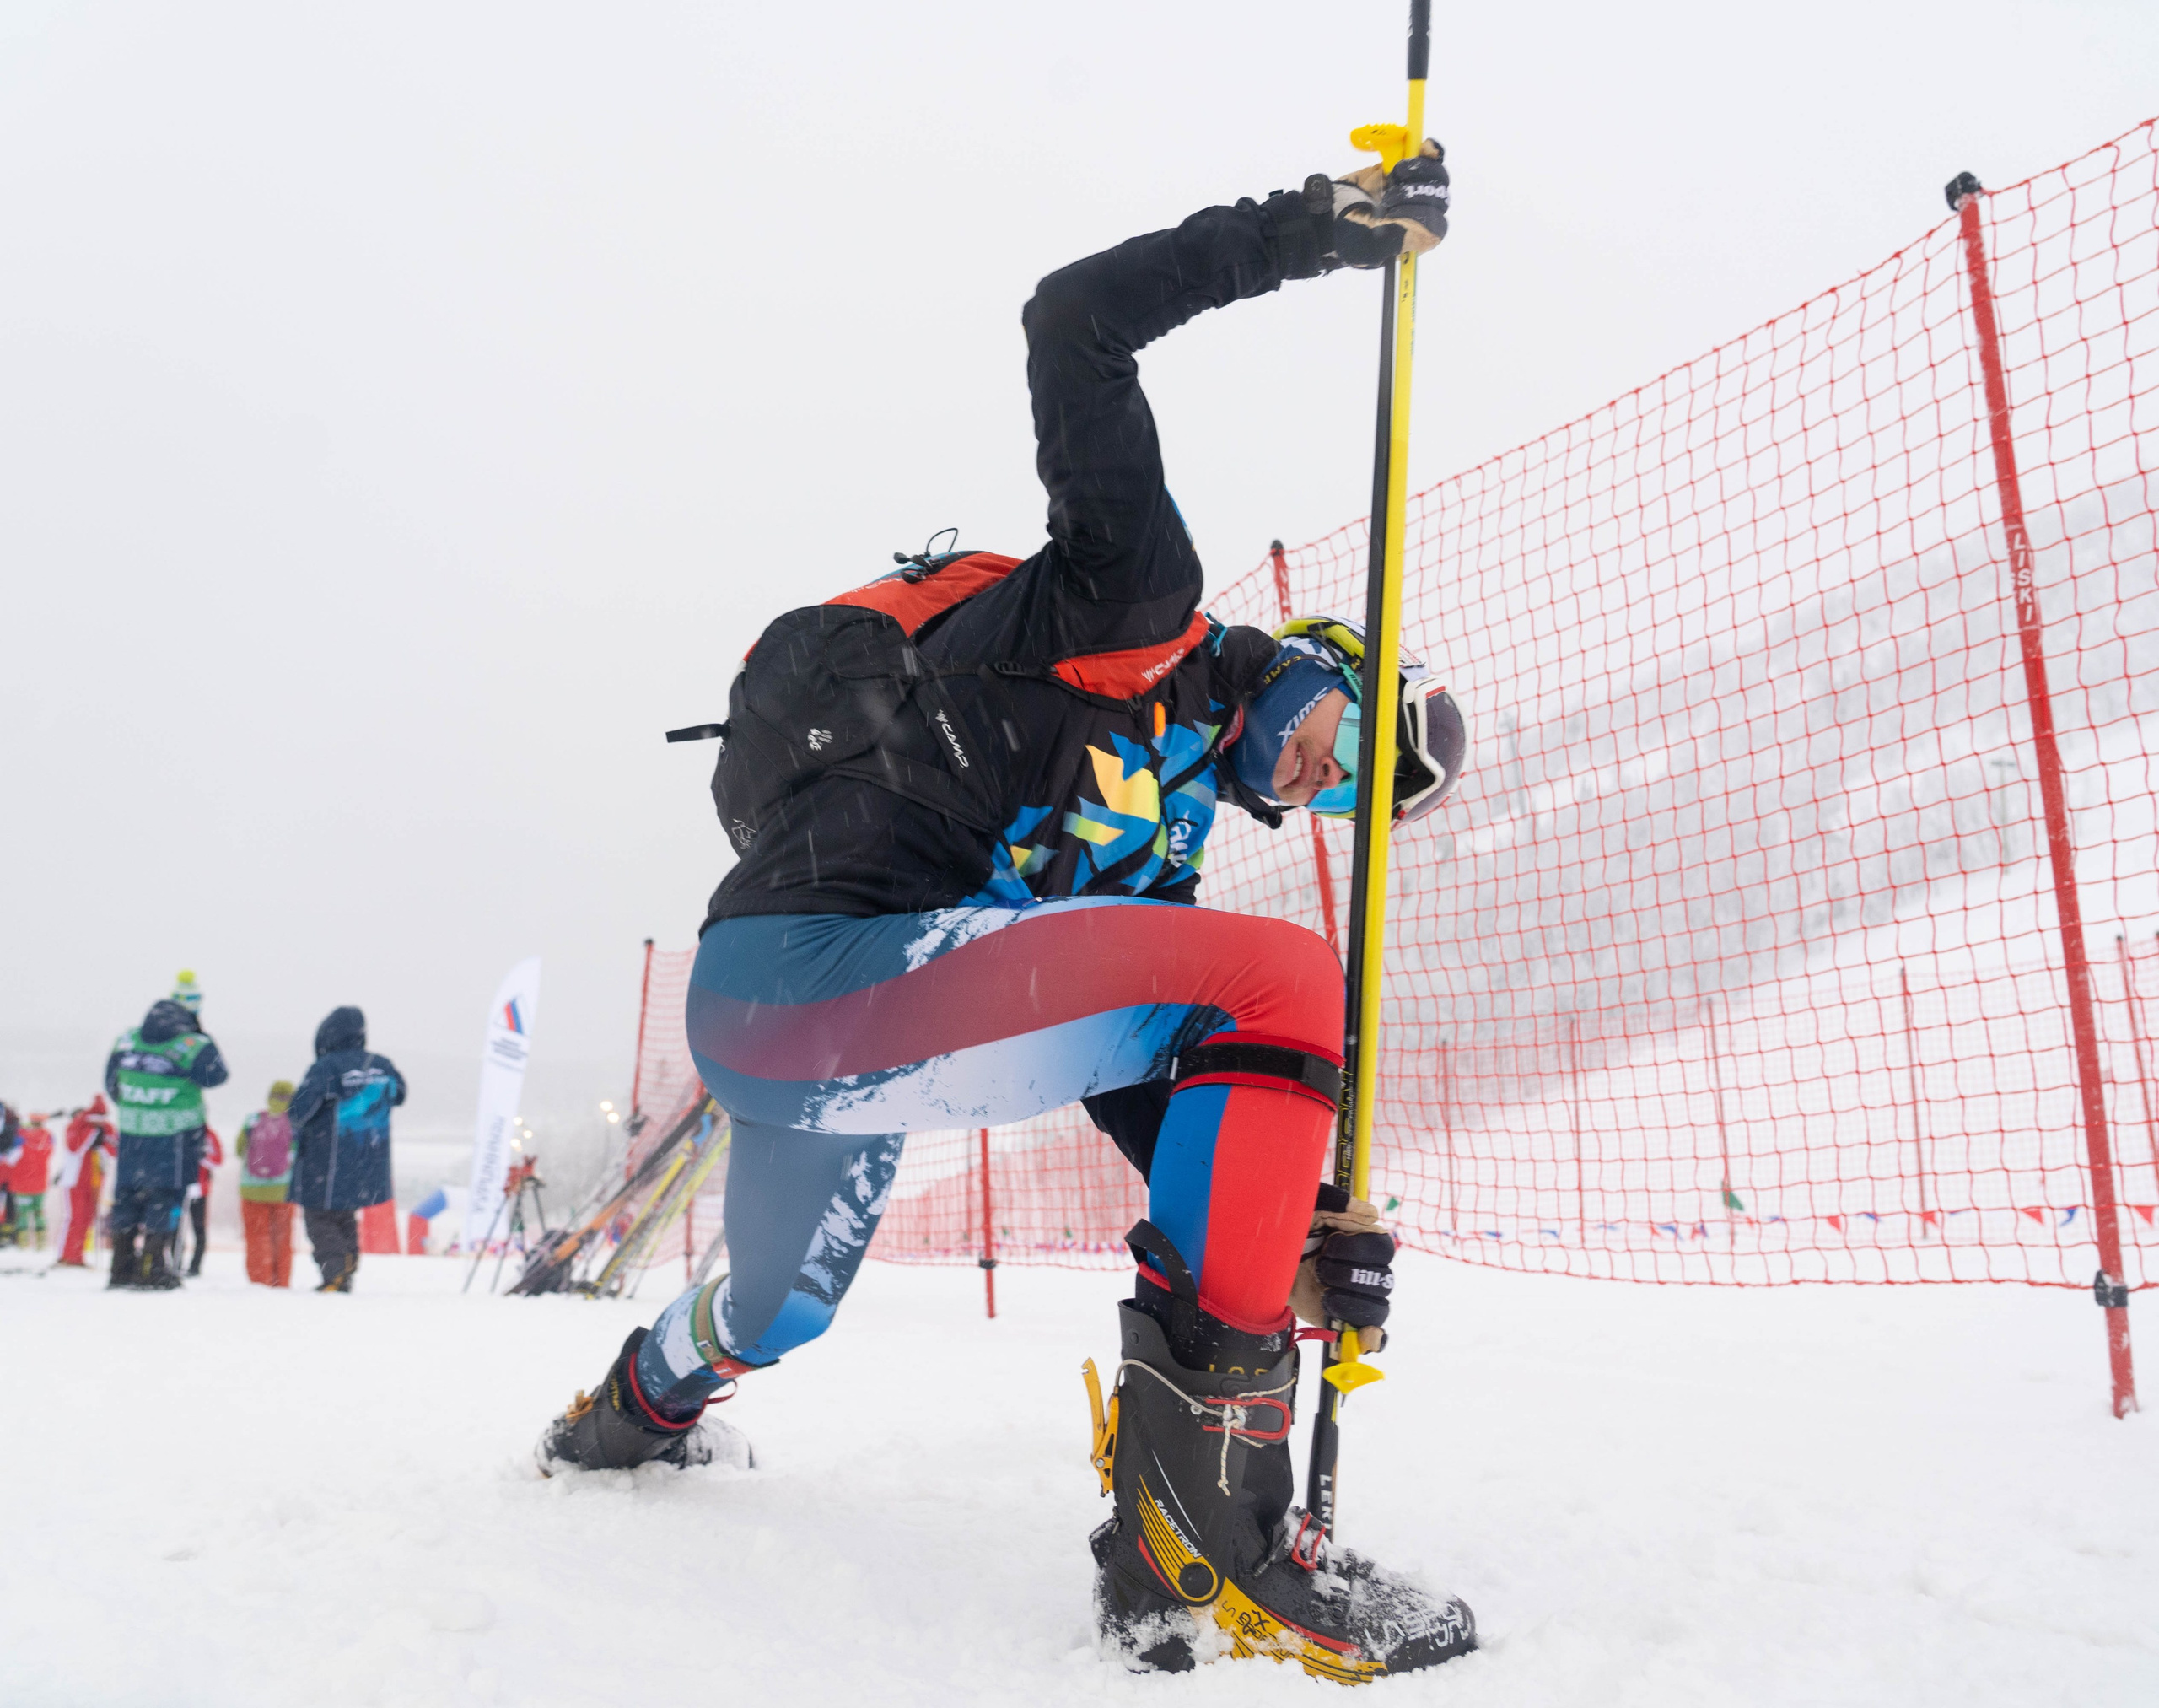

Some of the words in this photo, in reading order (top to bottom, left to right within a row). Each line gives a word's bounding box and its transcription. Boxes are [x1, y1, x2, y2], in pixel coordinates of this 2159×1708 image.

[2014, 532, 2034, 622] LISKI
[940, 723, 970, 769] CAMP
[119, 1082, 179, 1105] TAFF
[1154, 1497, 1202, 1560] RACETRON
